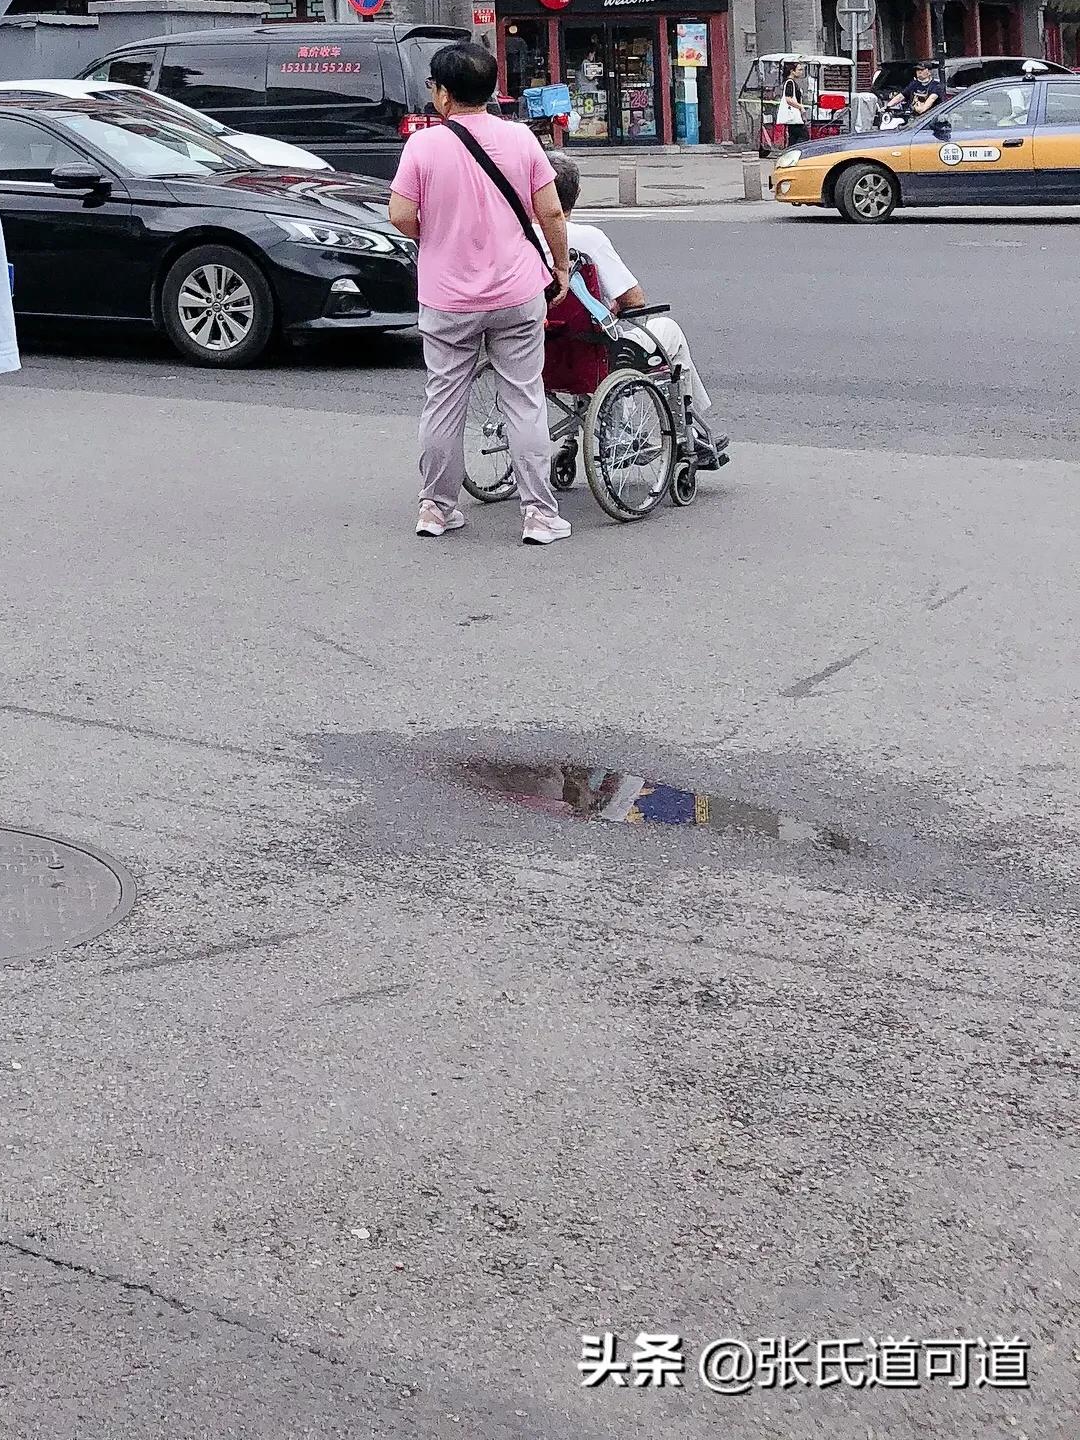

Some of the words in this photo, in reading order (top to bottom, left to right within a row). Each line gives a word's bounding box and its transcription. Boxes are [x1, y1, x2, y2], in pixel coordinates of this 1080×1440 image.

[297, 46, 341, 58] 高价收车
[280, 62, 360, 73] 15311155282
